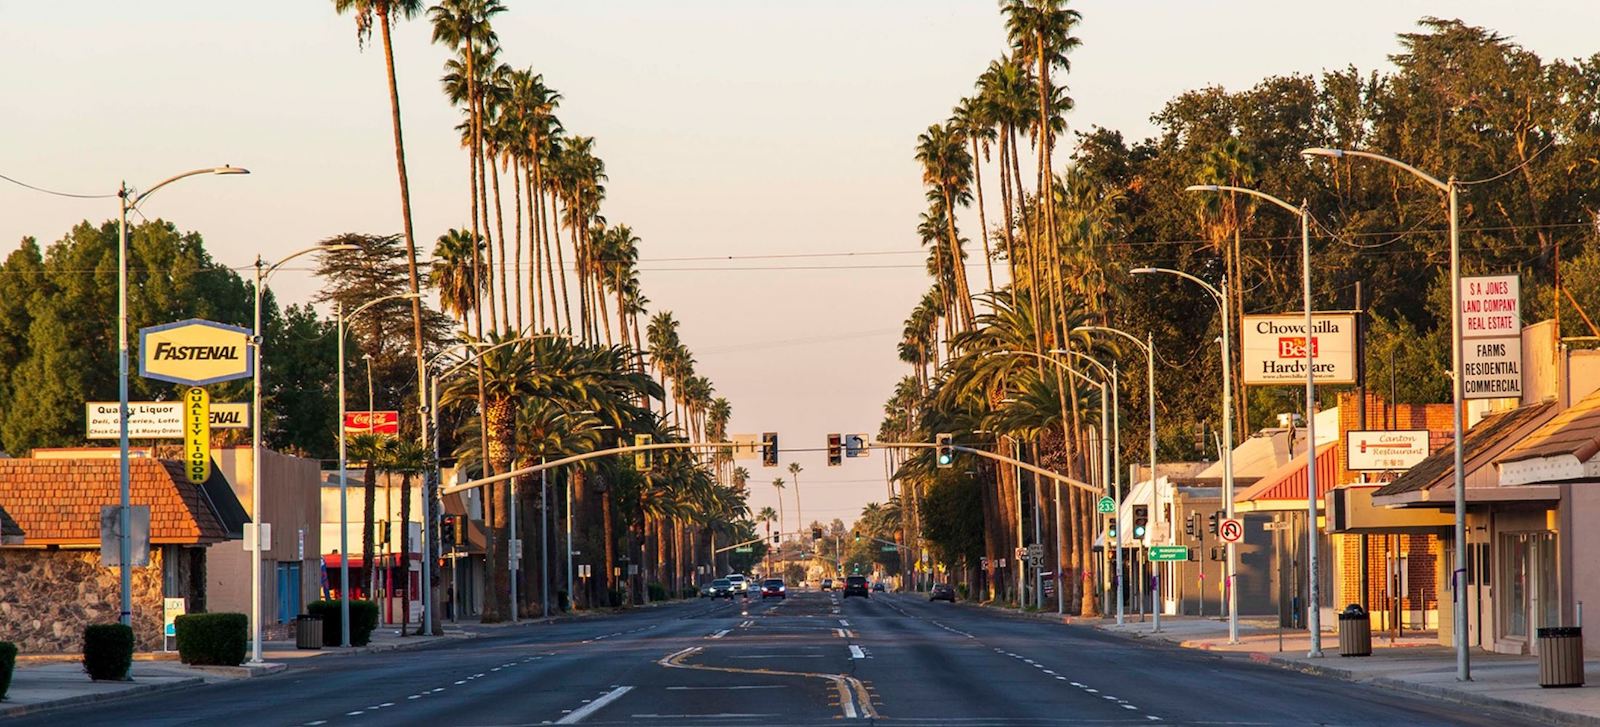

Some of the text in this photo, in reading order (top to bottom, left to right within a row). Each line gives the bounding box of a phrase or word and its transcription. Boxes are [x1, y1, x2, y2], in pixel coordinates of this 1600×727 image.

[1469, 281, 1509, 296] S A JONES
[1463, 298, 1517, 313] LAND COMPANY
[1468, 316, 1513, 330] REAL ESTATE
[153, 342, 239, 361] FASTENAL
[1281, 340, 1317, 357] Best
[1477, 344, 1506, 357] FARMS
[1465, 361, 1519, 376] RESIDENTIAL
[1465, 379, 1520, 393] COMMERCIAL
[98, 405, 174, 415] Quay Liquor
[209, 412, 241, 424] ENAL
[191, 388, 204, 480] QUALITY LIQUOR
[1379, 434, 1416, 442] Canton
[1372, 447, 1424, 455] Restaurant
[1099, 503, 1115, 512] 233
